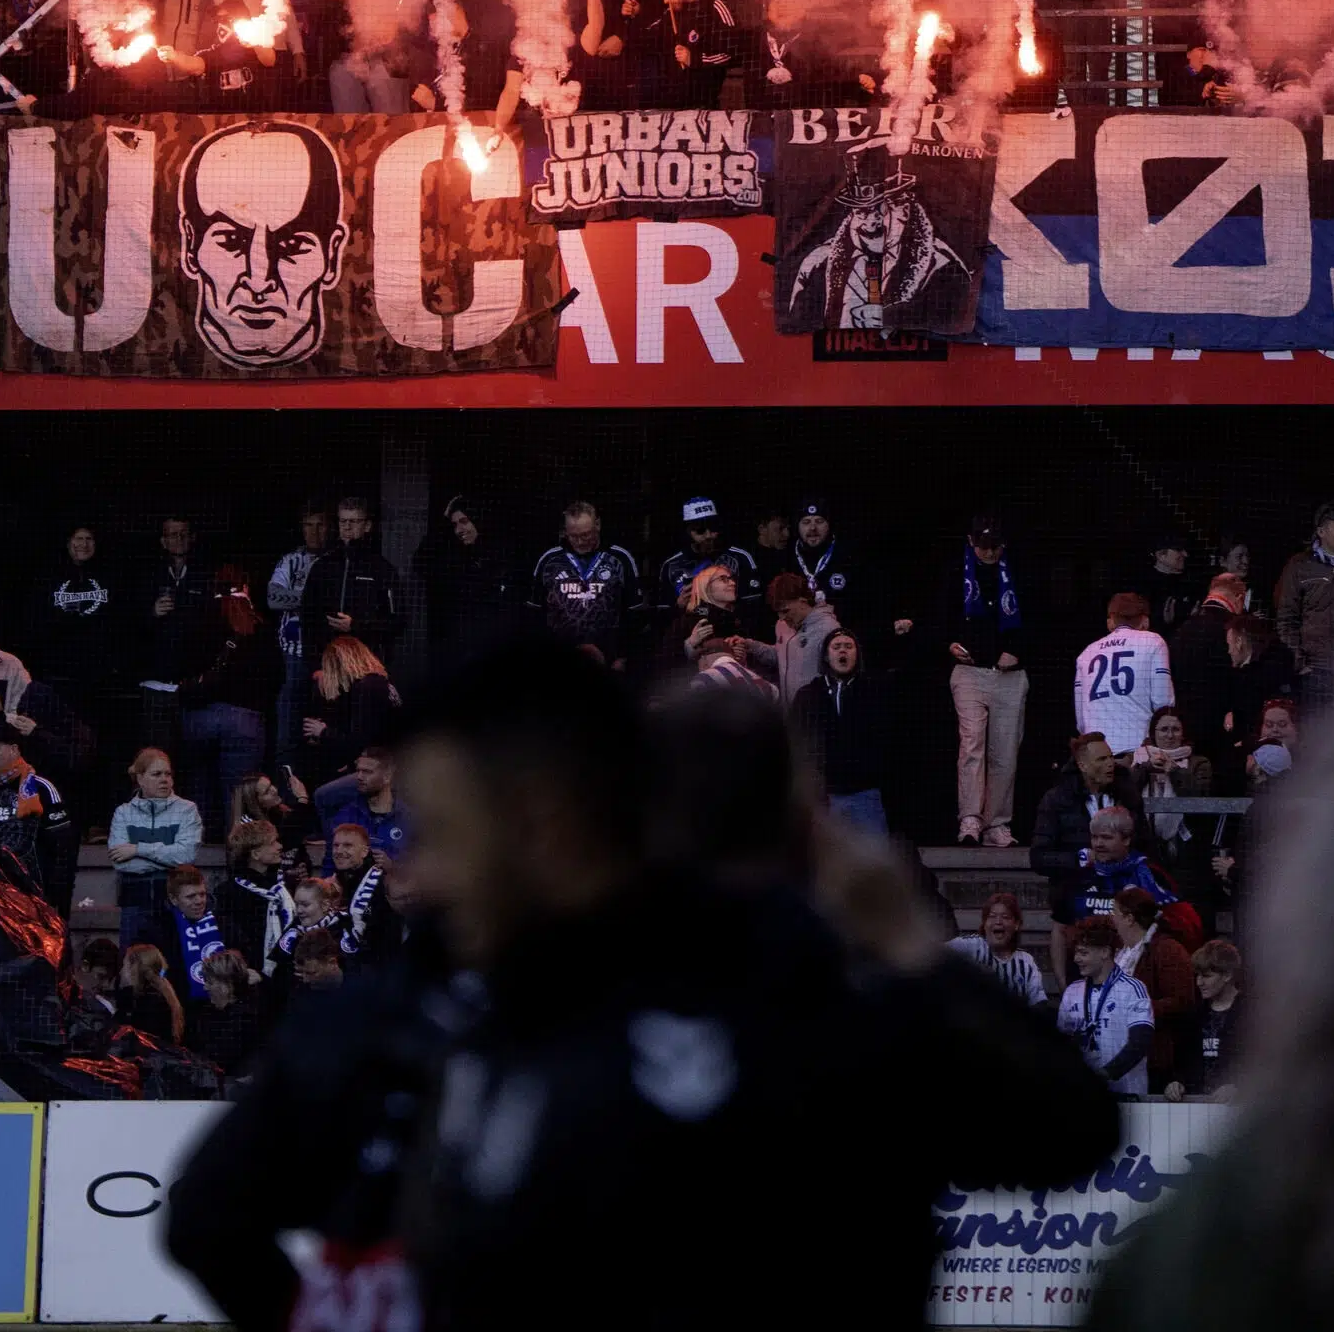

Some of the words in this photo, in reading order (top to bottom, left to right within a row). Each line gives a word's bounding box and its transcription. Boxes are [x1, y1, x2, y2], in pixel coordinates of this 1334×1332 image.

[549, 111, 751, 159] URBAN
[911, 143, 985, 159] BARONEN
[535, 152, 757, 209] JUNIORS
[8, 126, 157, 353] U
[373, 123, 525, 352] C
[1087, 650, 1135, 702] 25
[942, 1257, 1002, 1274] WHERE
[1007, 1257, 1081, 1274] LEGENDS
[928, 1286, 1014, 1303] FESTER
[1043, 1285, 1092, 1303] KON
